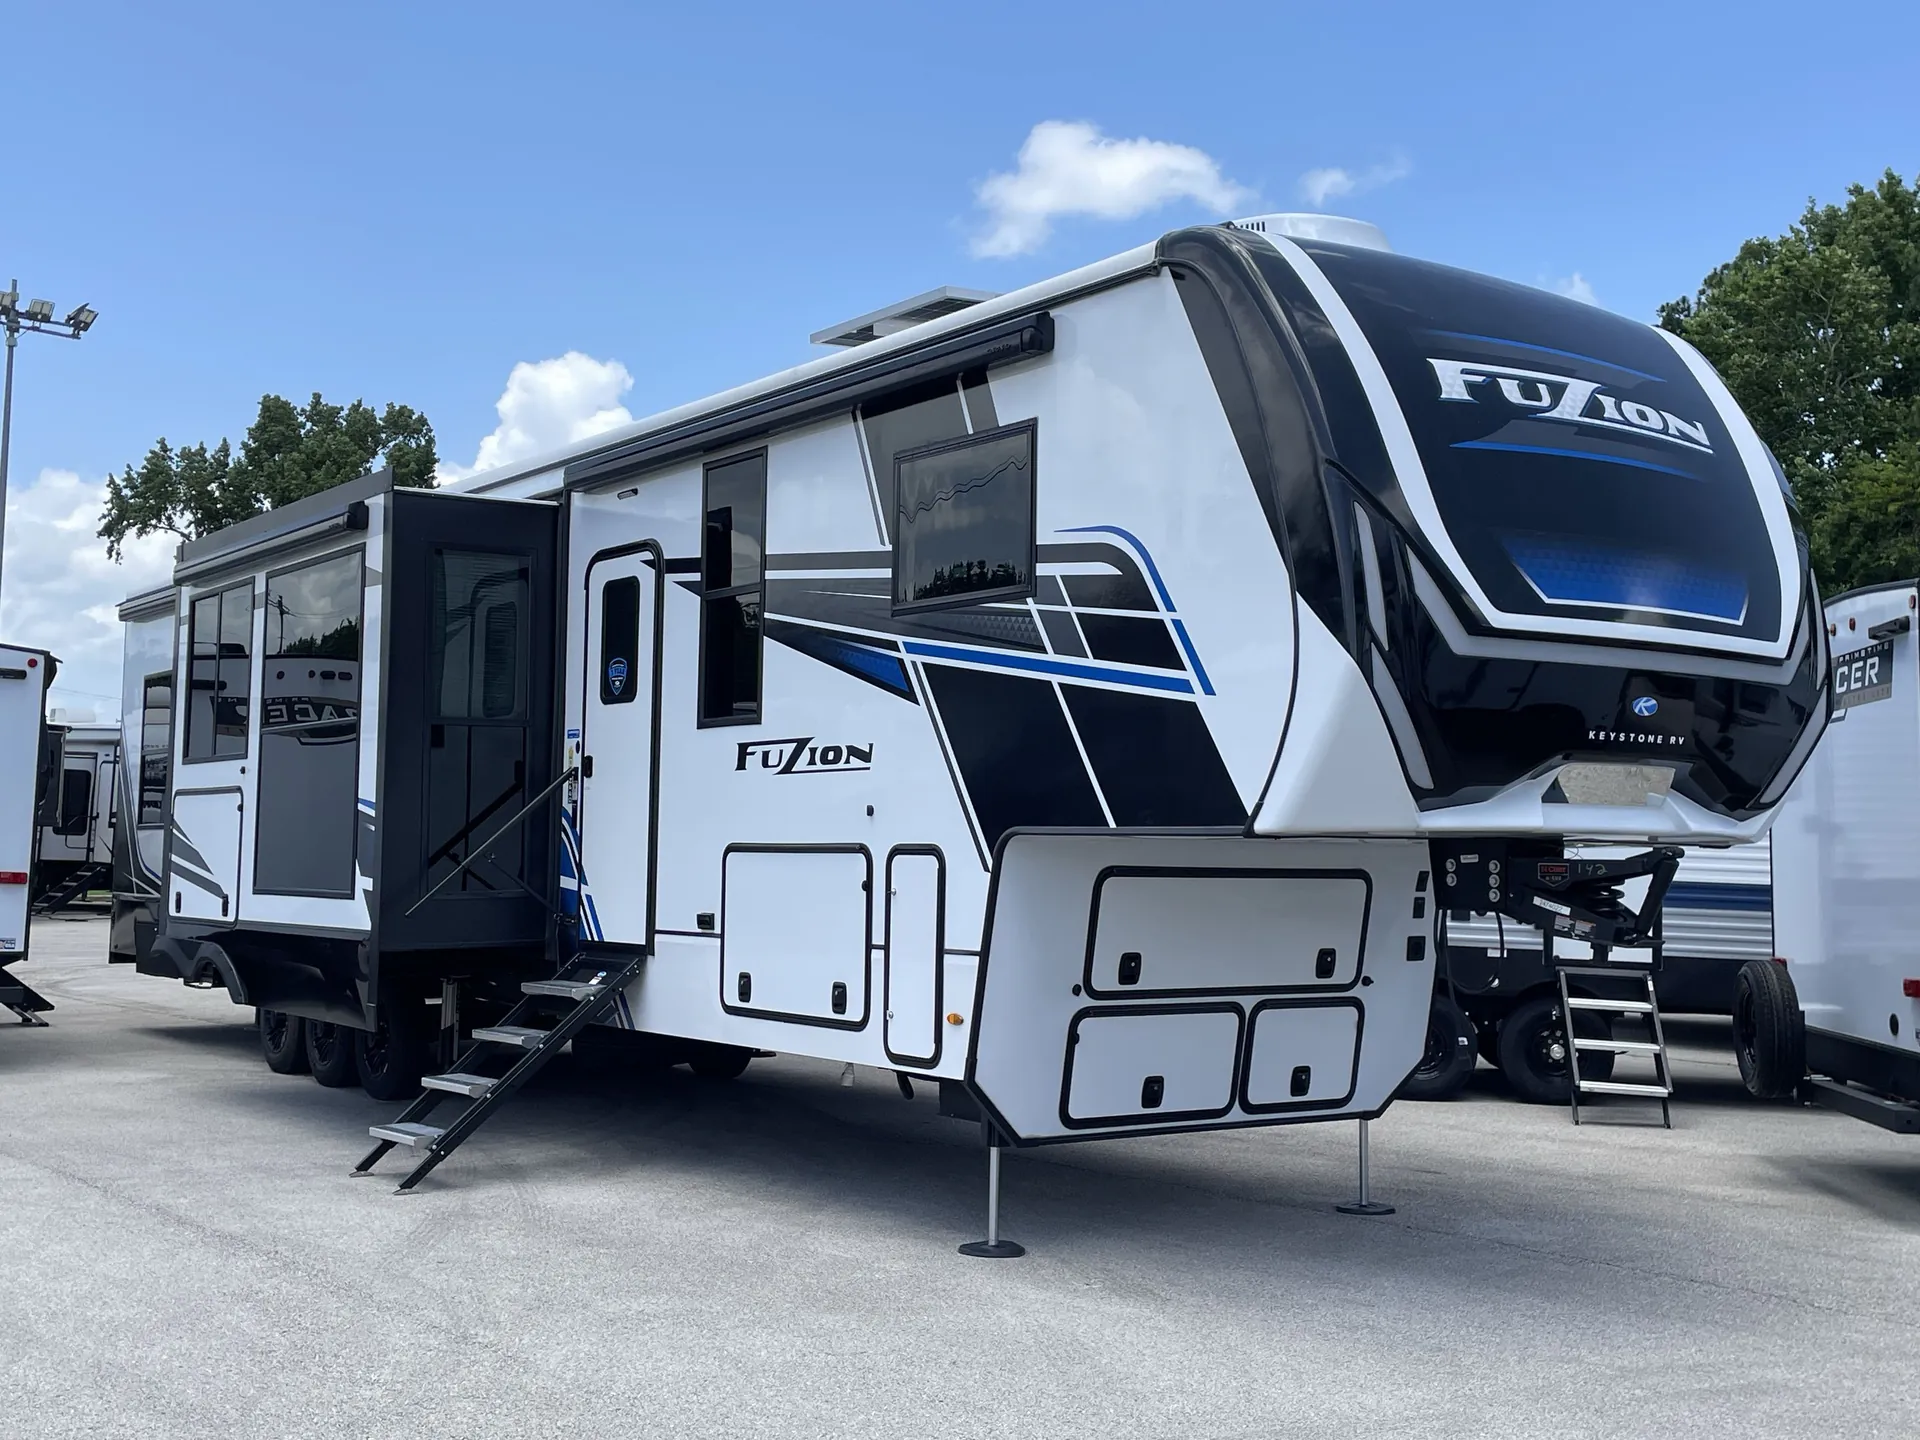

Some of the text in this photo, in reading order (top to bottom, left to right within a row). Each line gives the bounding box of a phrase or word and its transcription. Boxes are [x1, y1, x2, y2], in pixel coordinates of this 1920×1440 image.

[1426, 358, 1714, 454] FUZION
[1588, 730, 1685, 745] KEYSTONE RV
[735, 737, 874, 775] FUZION
[1578, 863, 1608, 876] 142
